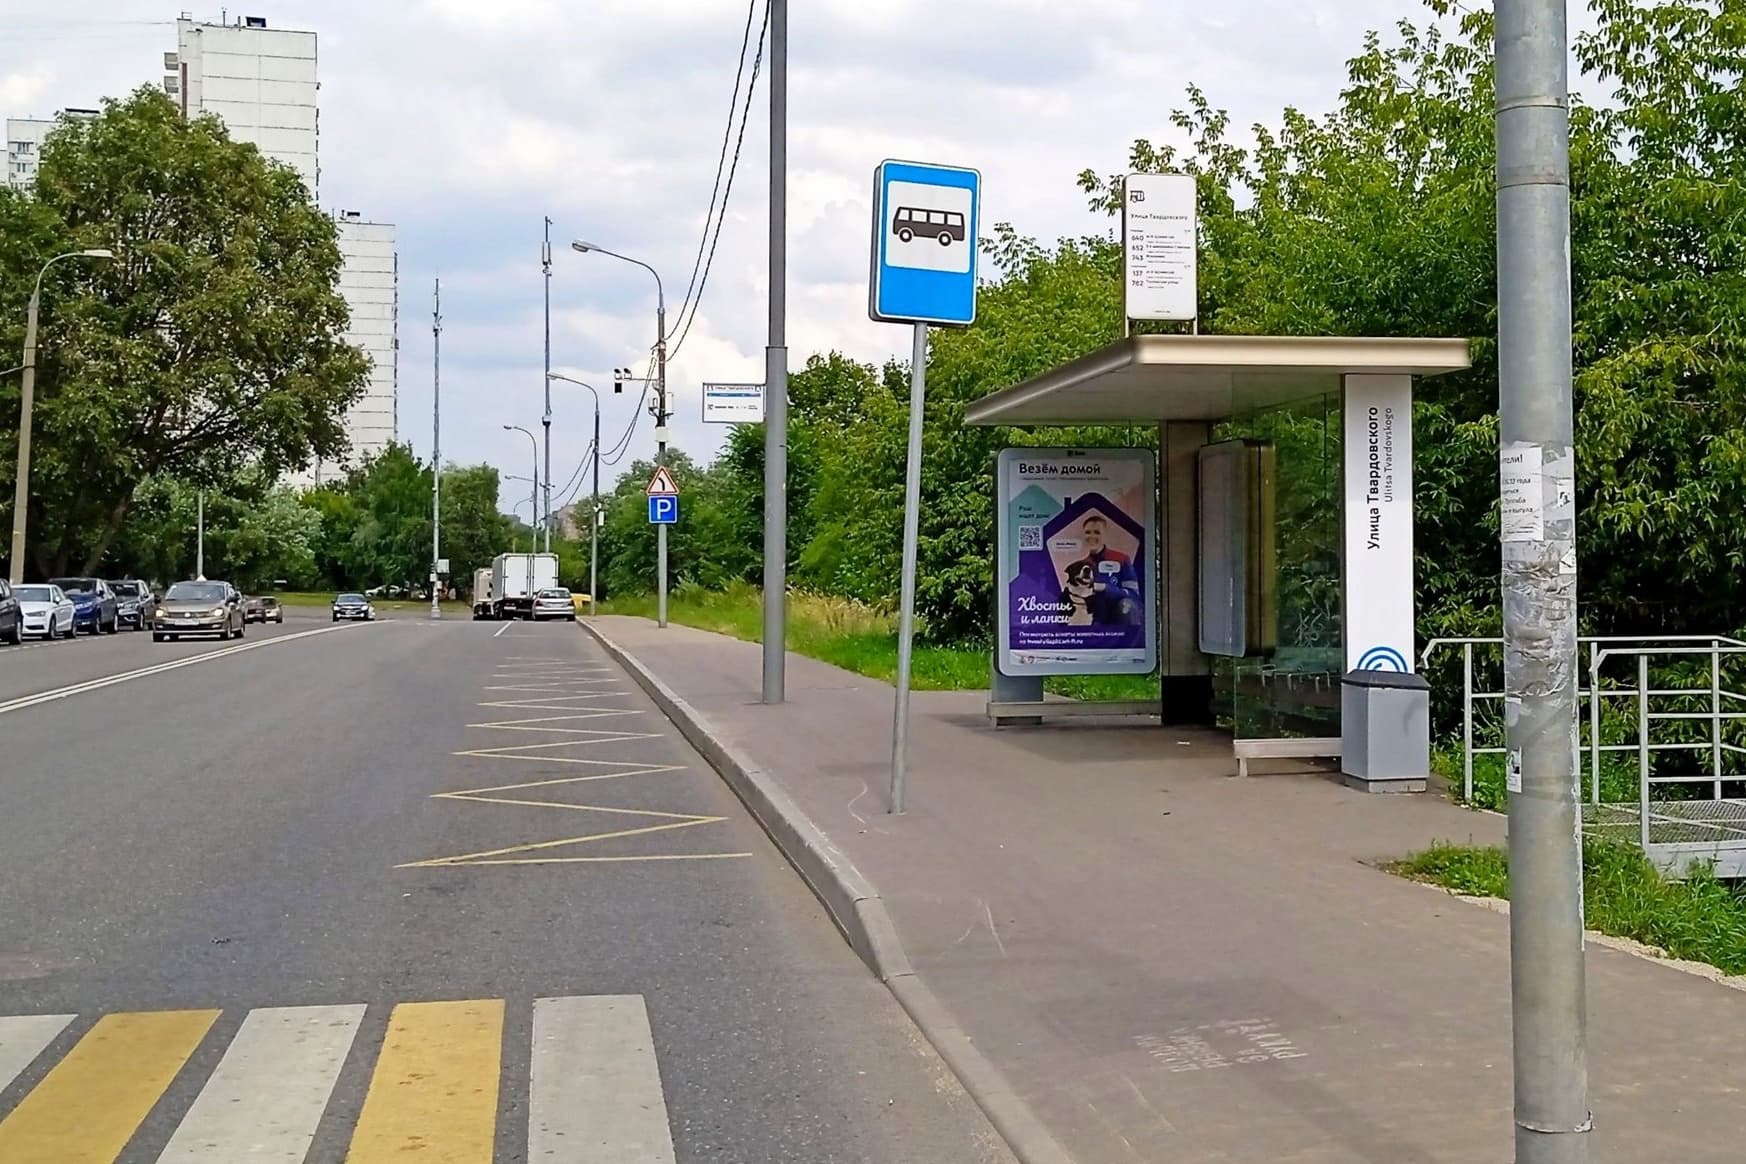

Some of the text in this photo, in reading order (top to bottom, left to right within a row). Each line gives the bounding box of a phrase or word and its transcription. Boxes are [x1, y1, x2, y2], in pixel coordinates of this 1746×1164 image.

[1384, 408, 1394, 502] Ulitsa Tvardovskogo
[1019, 463, 1101, 475] Везём домой
[1366, 407, 1381, 550] Улица Твардовского
[656, 499, 672, 520] P
[1018, 596, 1072, 612] Хвосты
[1021, 614, 1070, 624] и лапки
